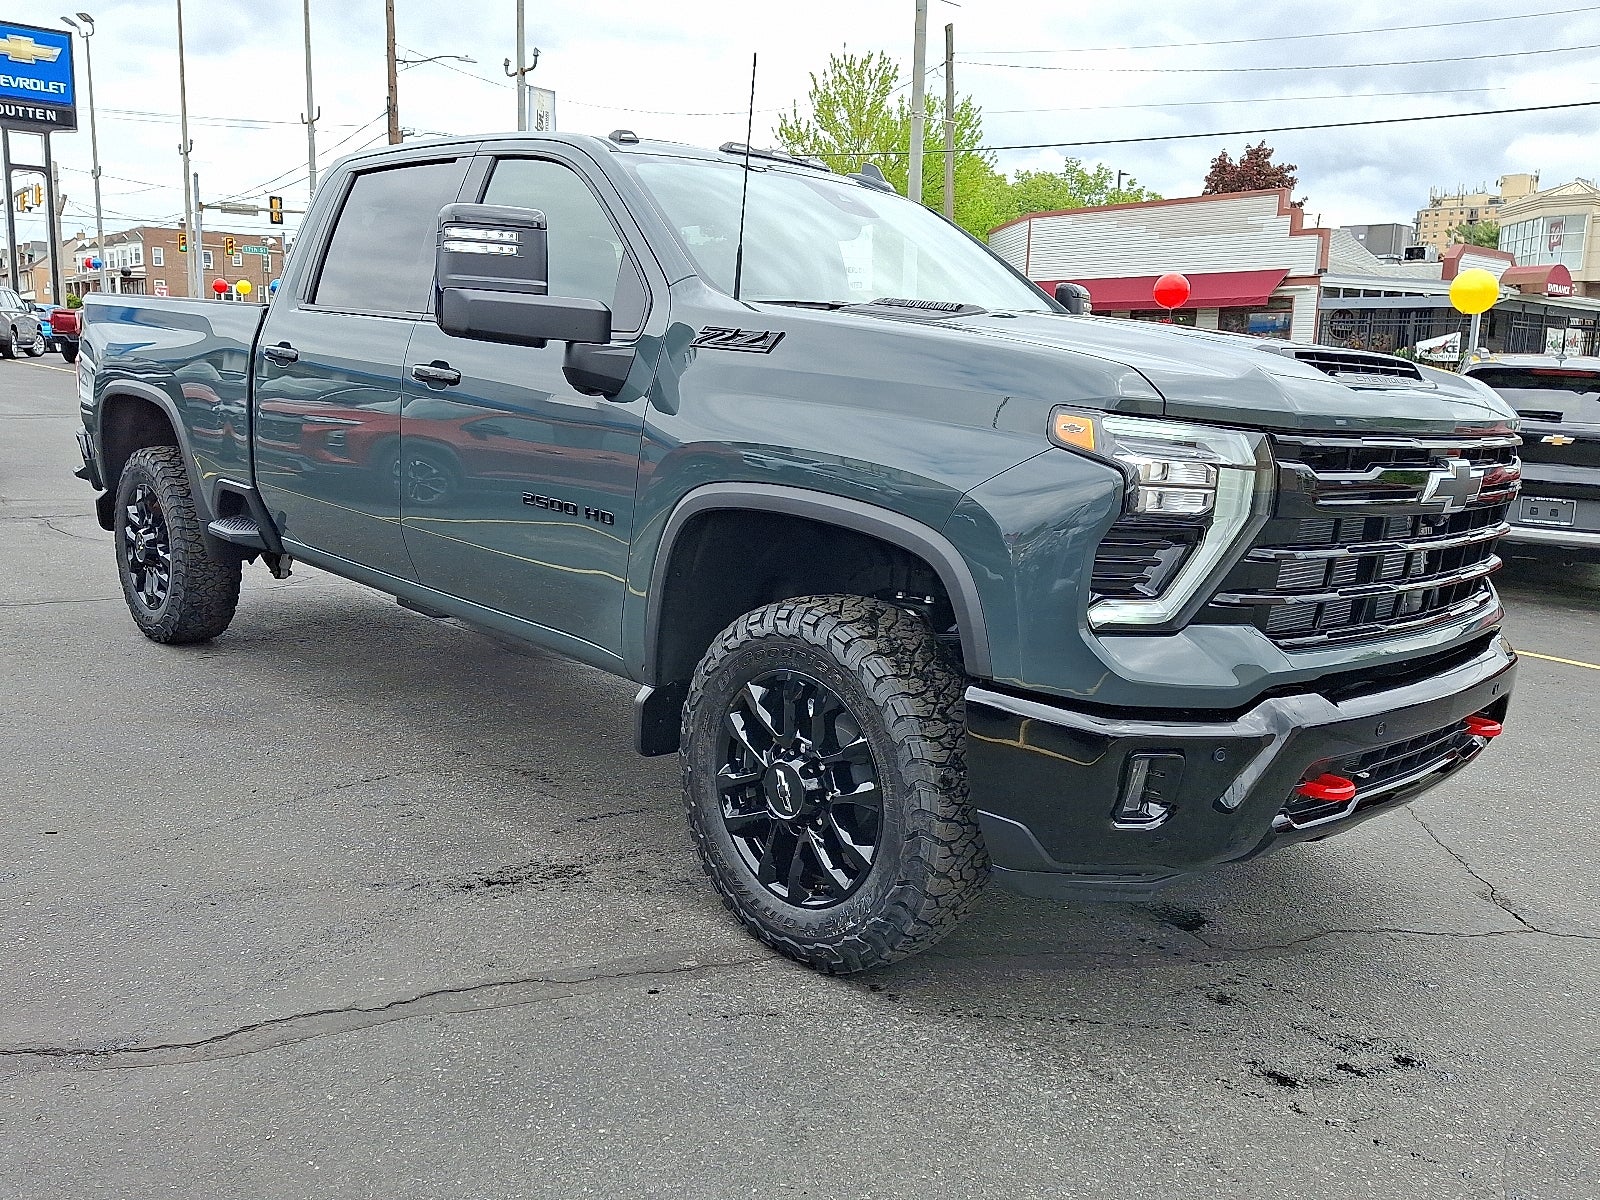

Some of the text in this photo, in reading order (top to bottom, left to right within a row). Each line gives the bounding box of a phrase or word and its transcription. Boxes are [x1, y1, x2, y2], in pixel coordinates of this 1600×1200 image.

[903, 299, 964, 313] DURAMAX
[689, 325, 787, 355] Z71
[1355, 375, 1412, 385] CHEVROLET
[522, 490, 615, 526] 2500 HD
